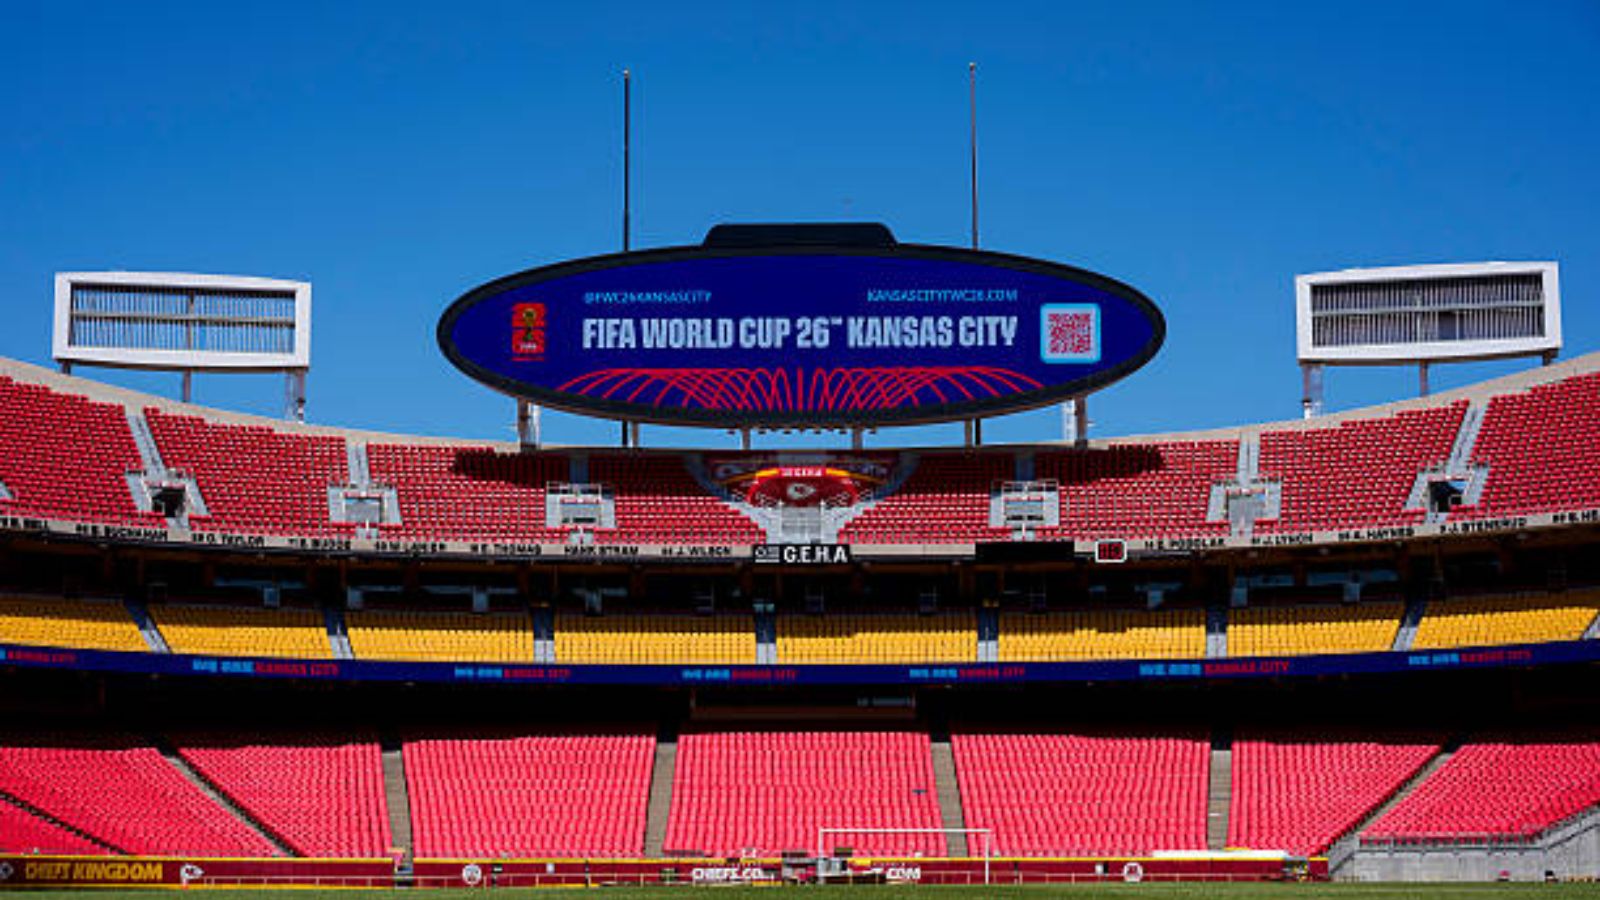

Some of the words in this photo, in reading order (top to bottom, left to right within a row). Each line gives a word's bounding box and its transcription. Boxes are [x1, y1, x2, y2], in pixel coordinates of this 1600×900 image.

[582, 318, 636, 349] FIFA
[641, 318, 734, 349] WORLD
[739, 317, 791, 349] CUP
[847, 316, 953, 347] KANSAS
[958, 316, 1018, 346] CITY
[73, 863, 163, 880] KINGDOM
